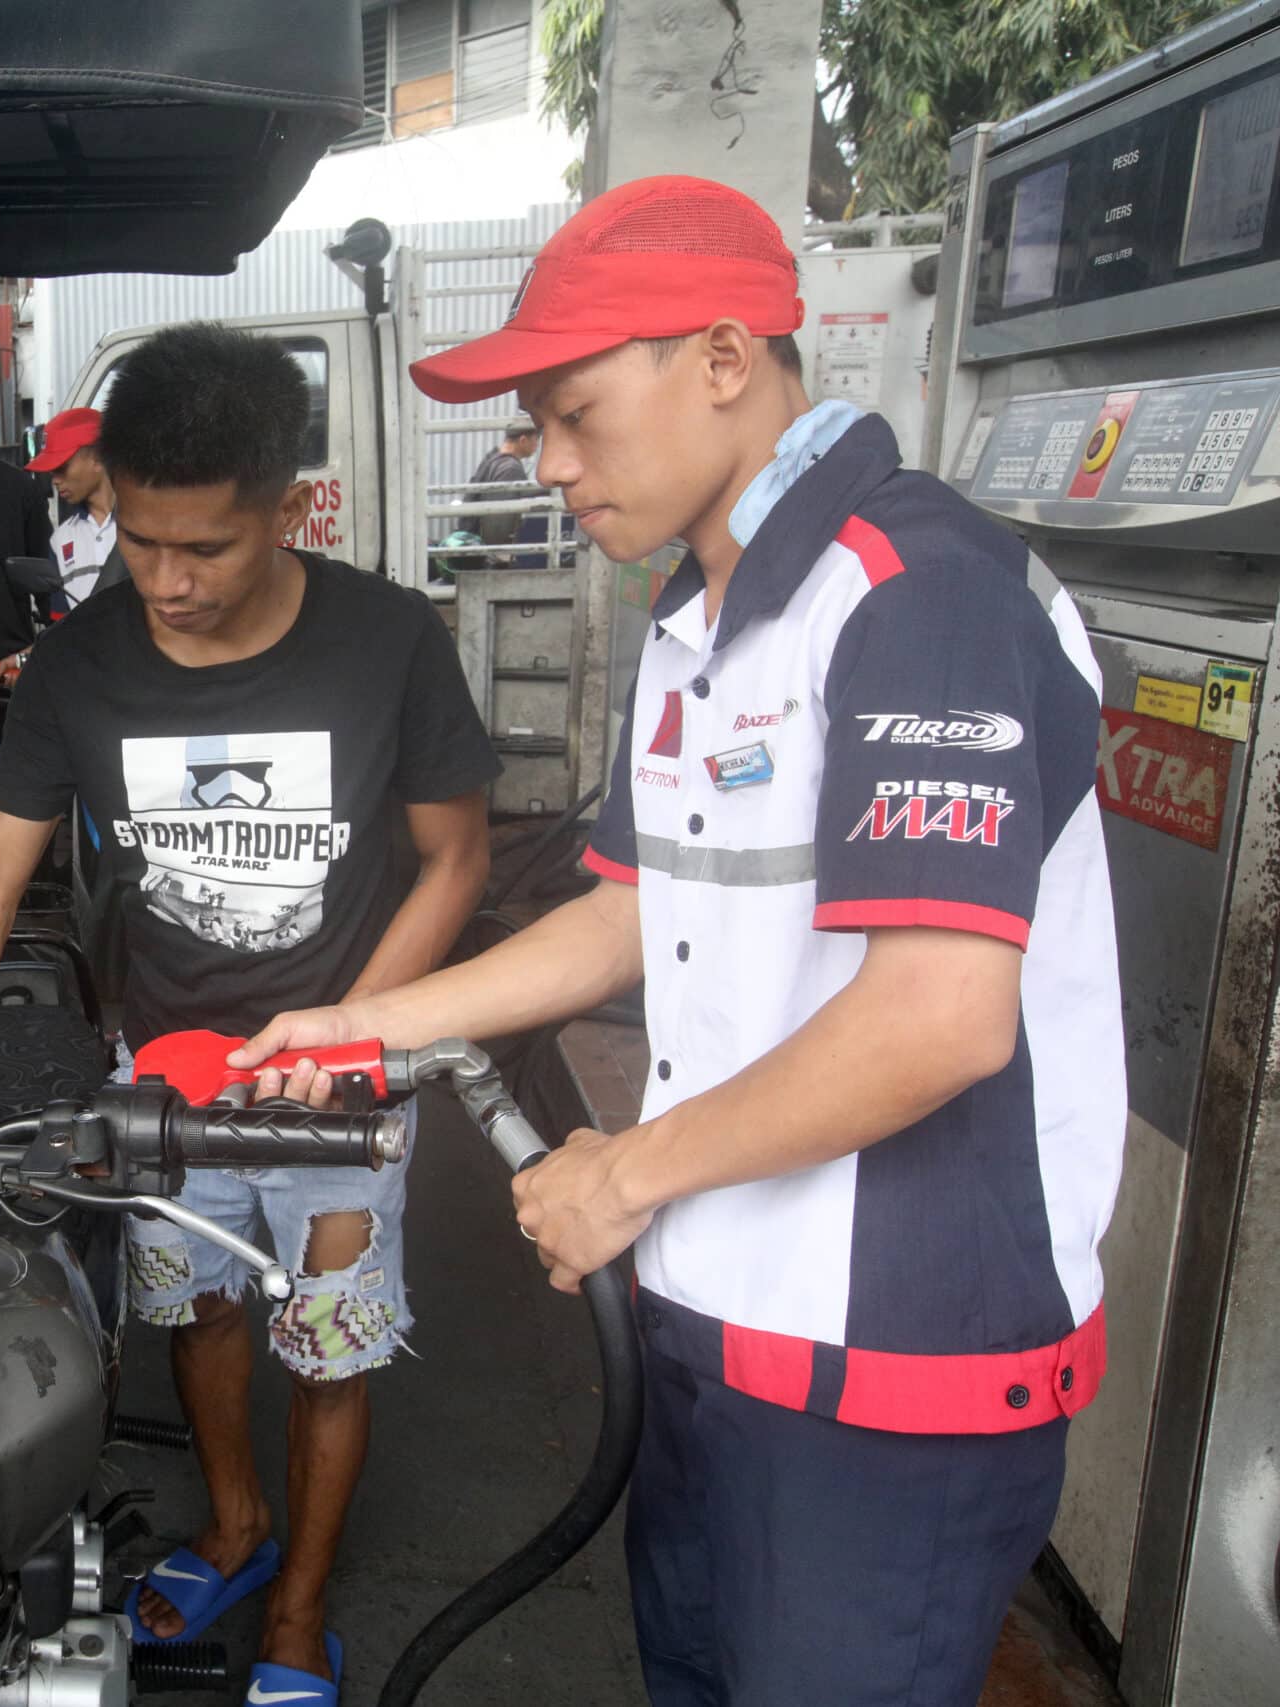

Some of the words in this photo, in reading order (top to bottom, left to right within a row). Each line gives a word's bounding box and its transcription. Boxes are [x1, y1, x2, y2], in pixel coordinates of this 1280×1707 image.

[1112, 150, 1140, 171] PESOS
[1105, 203, 1133, 223] LITERS
[303, 515, 342, 548] INC.
[1207, 682, 1236, 717] 91
[855, 713, 998, 742] TURBO
[890, 736, 940, 744] DIESEL
[635, 766, 681, 790] PETRON
[1095, 717, 1218, 817] XTRA
[876, 780, 1015, 805] DIESEL
[845, 797, 1016, 846] MAX
[1129, 794, 1216, 835] ADVANCE
[113, 819, 351, 863] STORMTROOPER
[190, 855, 230, 868] STAR
[231, 858, 272, 872] WARS
